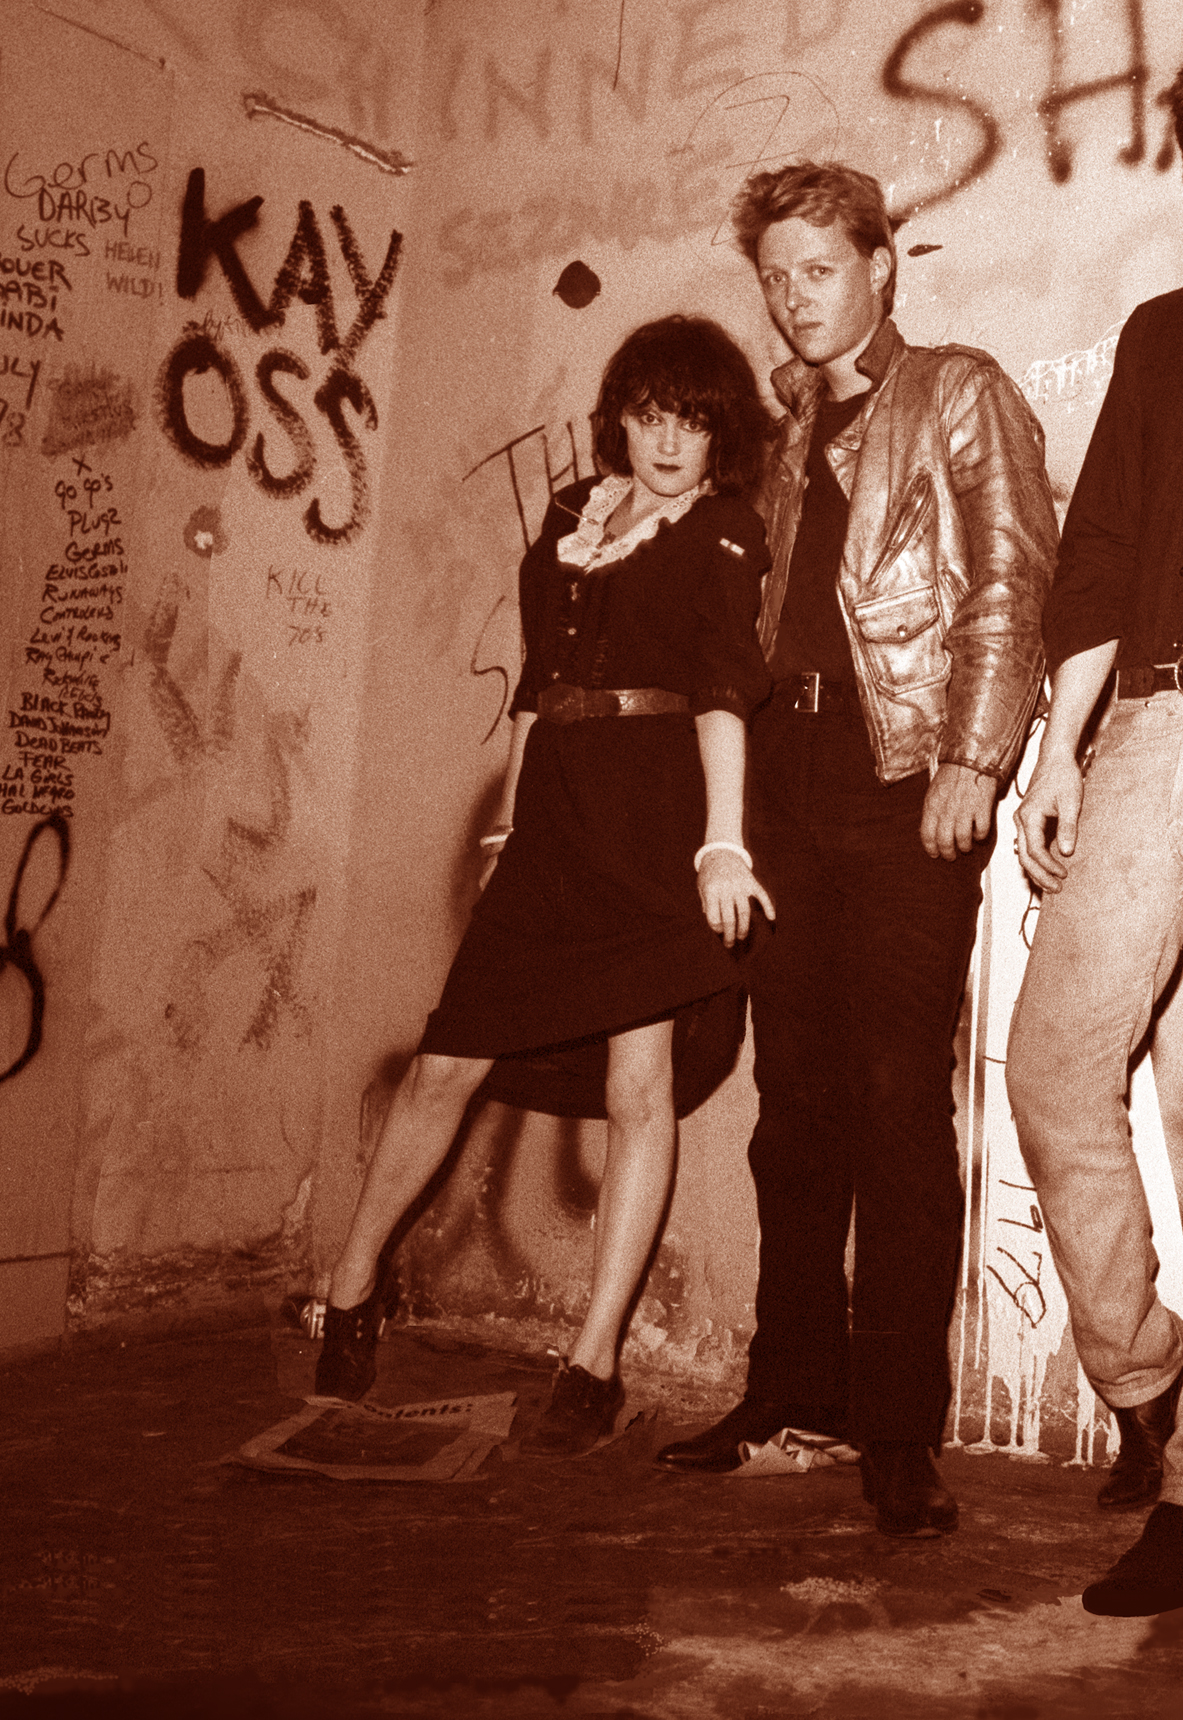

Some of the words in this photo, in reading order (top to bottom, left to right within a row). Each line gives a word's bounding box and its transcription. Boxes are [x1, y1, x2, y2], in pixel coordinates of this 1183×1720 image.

[17, 224, 90, 256] SUCKS
[177, 167, 403, 358] KAY
[266, 564, 328, 599] KILL
